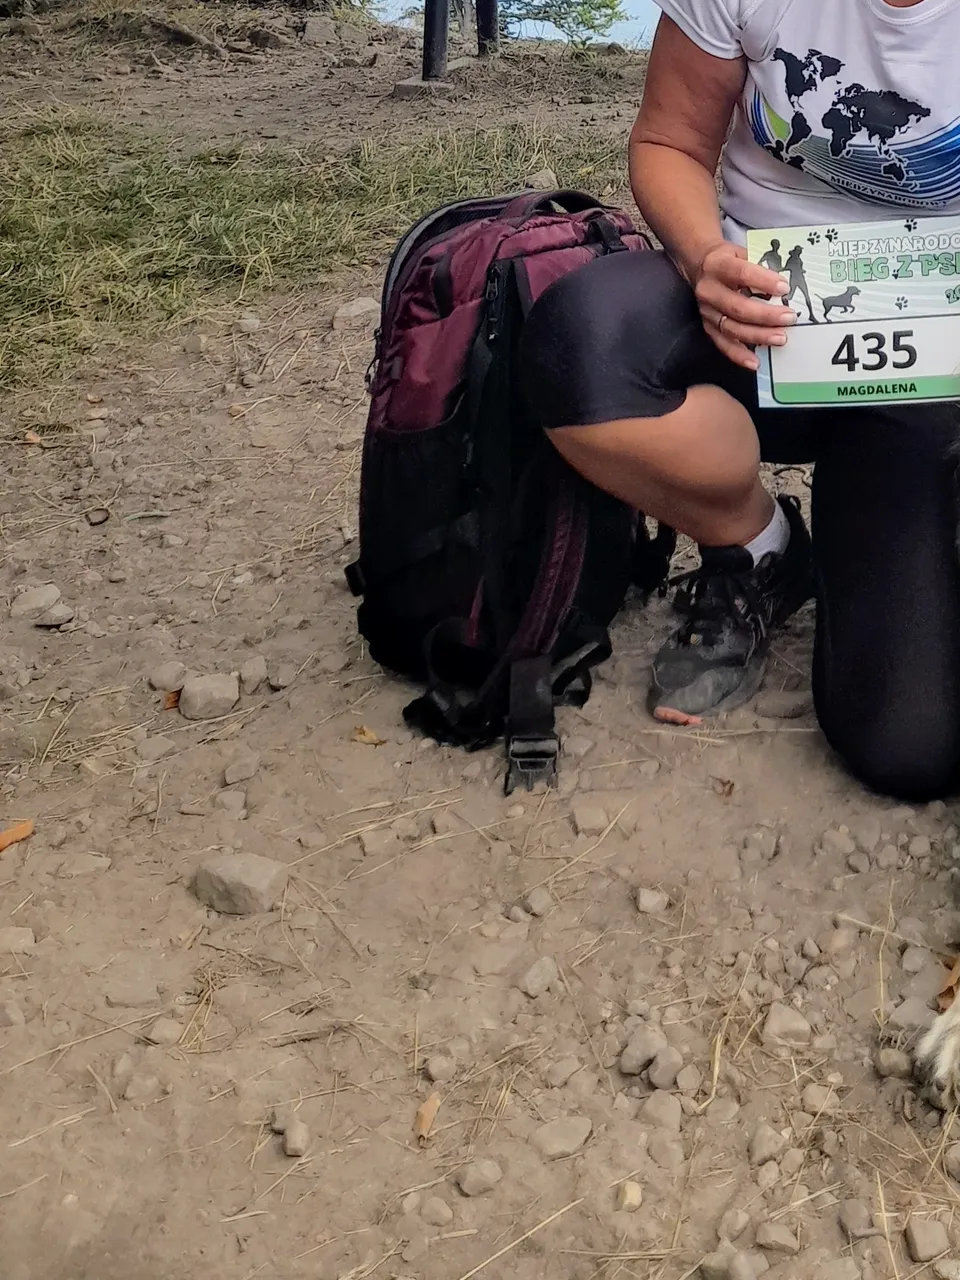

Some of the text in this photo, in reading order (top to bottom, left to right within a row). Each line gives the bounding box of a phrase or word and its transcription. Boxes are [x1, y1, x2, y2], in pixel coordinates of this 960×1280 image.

[830, 257, 889, 282] BIEG
[897, 255, 913, 278] Z
[831, 329, 918, 372] 435
[837, 383, 917, 397] MAGDALENA
